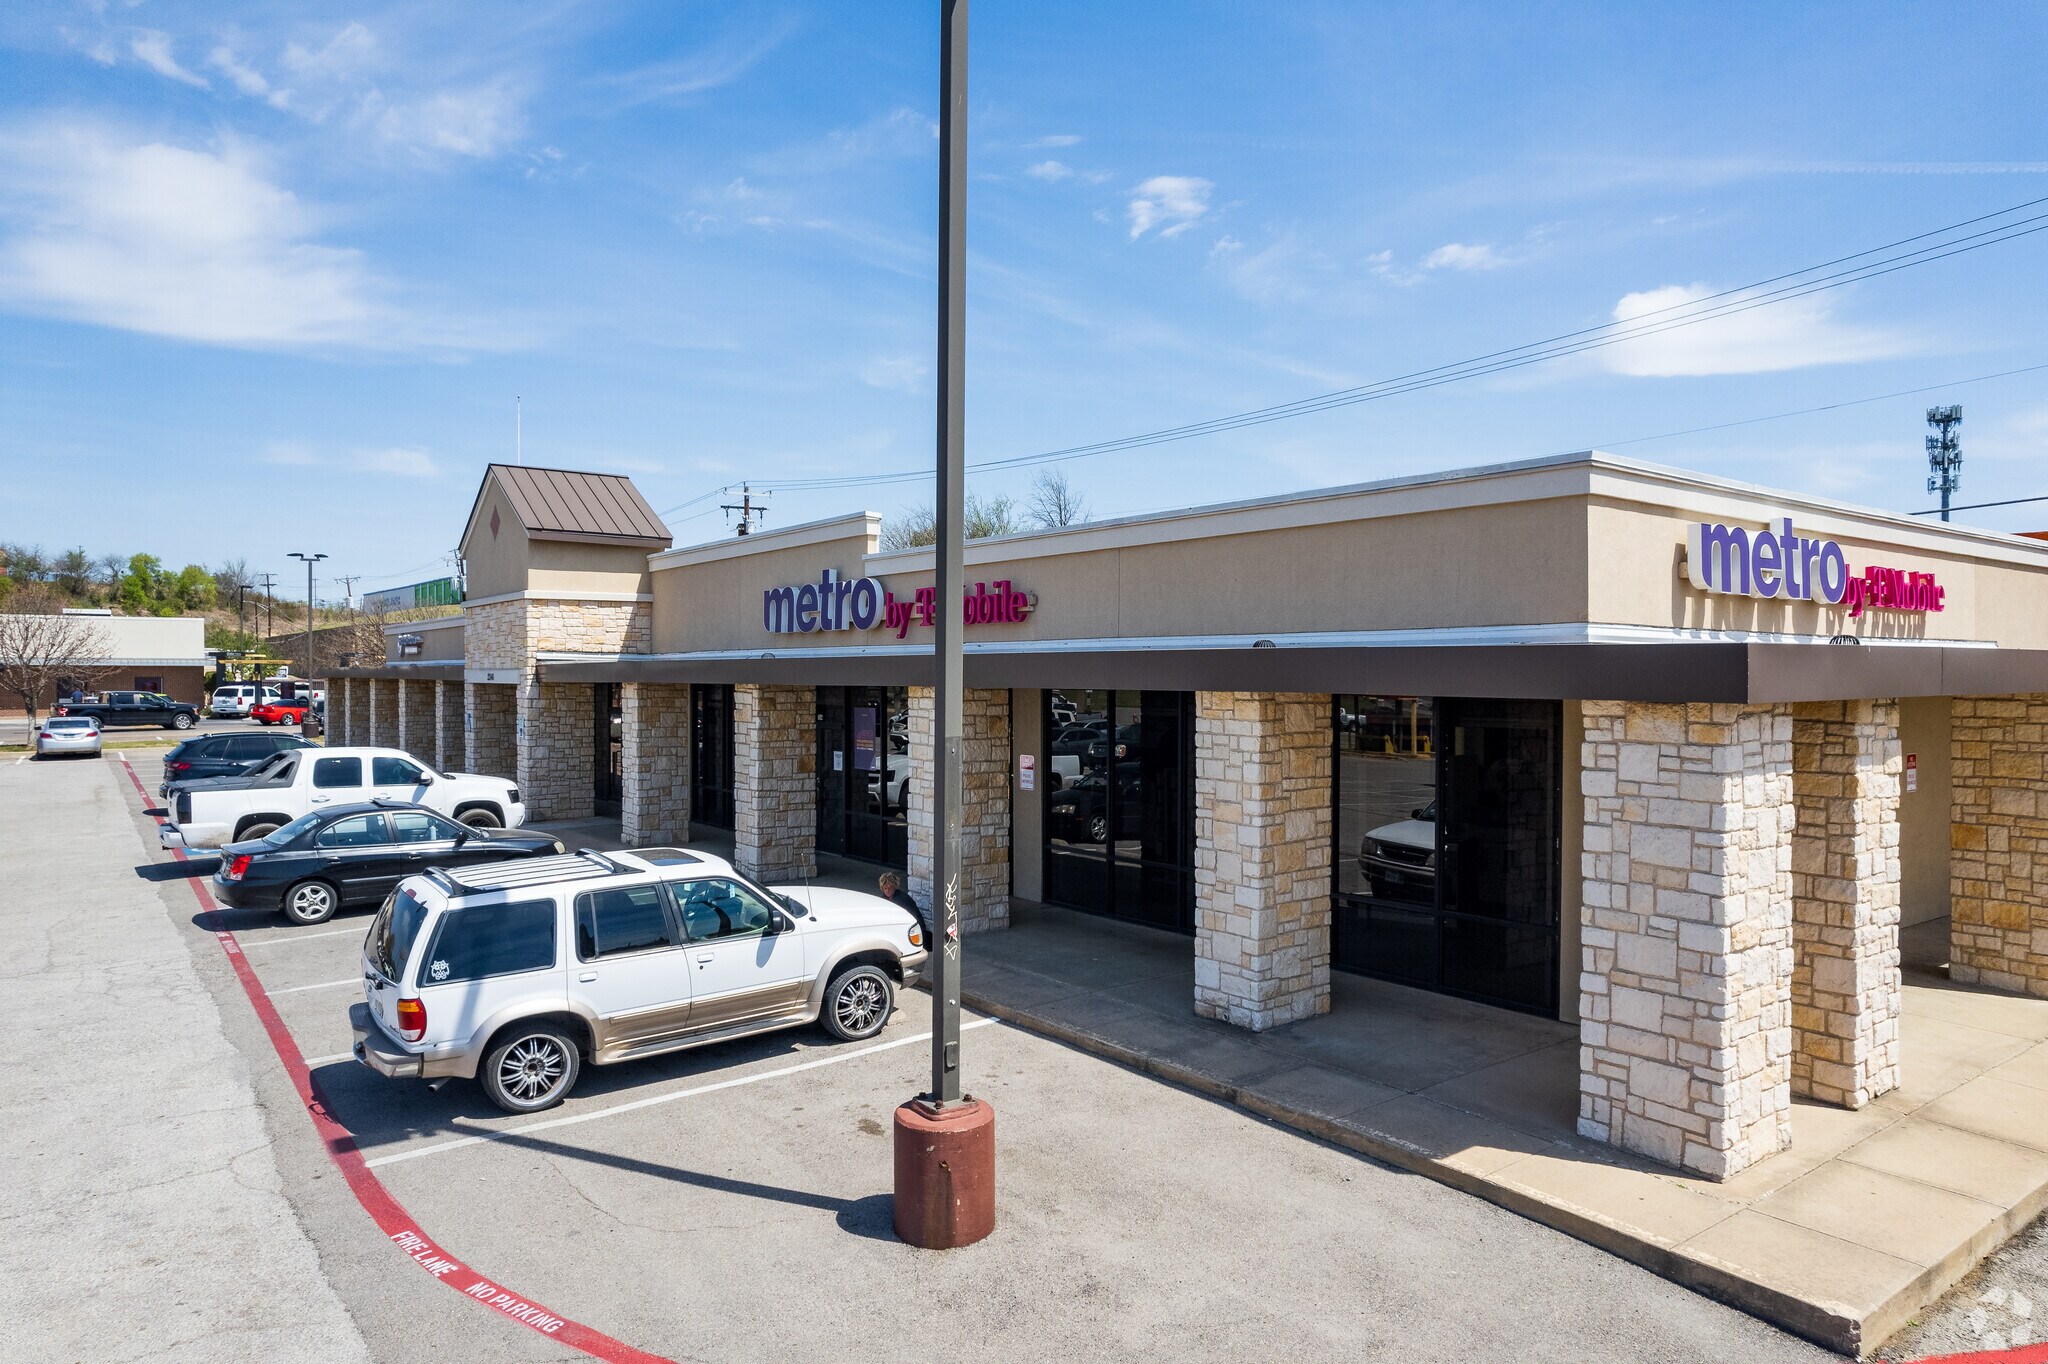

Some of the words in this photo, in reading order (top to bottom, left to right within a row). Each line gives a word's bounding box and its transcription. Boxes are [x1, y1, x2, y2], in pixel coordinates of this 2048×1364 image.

[763, 568, 884, 633] metro
[885, 591, 914, 639] by
[1687, 517, 1846, 604] metro
[1843, 563, 1868, 618] by
[390, 1230, 429, 1254] FIRE
[413, 1249, 459, 1277] LANE
[464, 1281, 497, 1299] NO
[487, 1293, 564, 1333] PARKING
